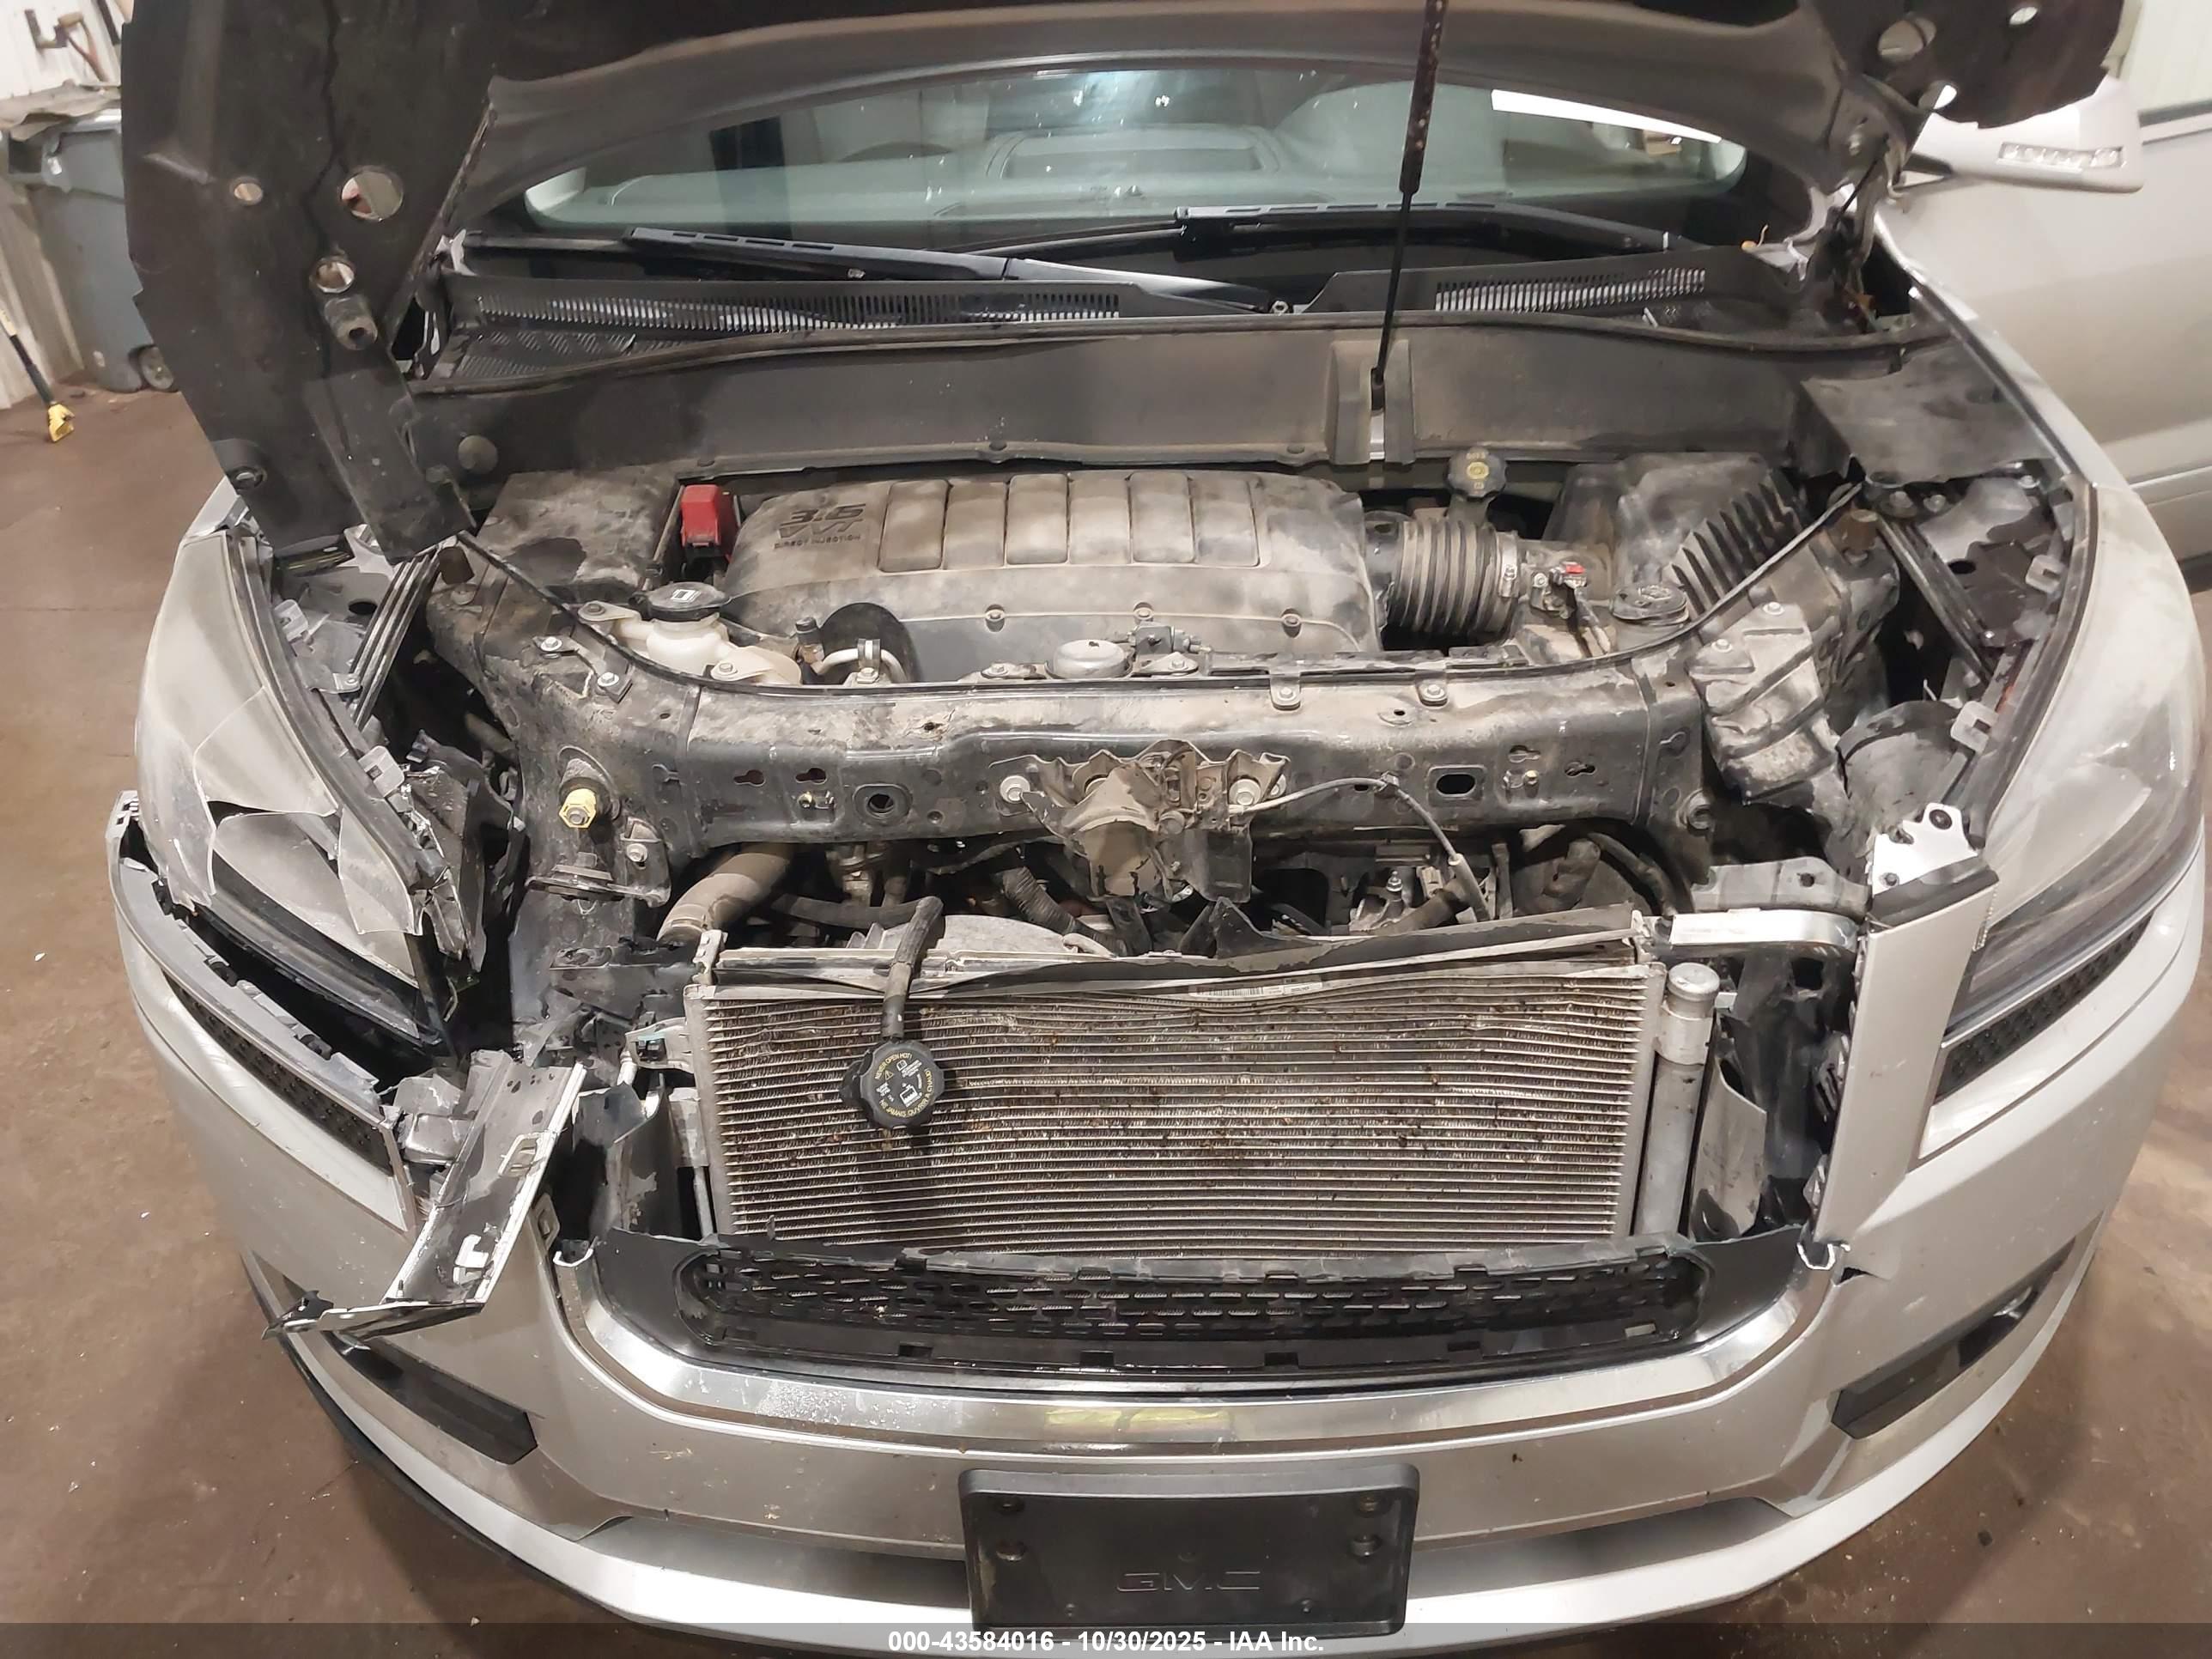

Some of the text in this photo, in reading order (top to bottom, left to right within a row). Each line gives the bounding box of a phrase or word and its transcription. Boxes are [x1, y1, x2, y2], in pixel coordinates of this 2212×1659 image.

[780, 503, 866, 526] 3.6
[885, 1053, 899, 1064] OPEN
[1116, 1571, 1261, 1592] GMC
